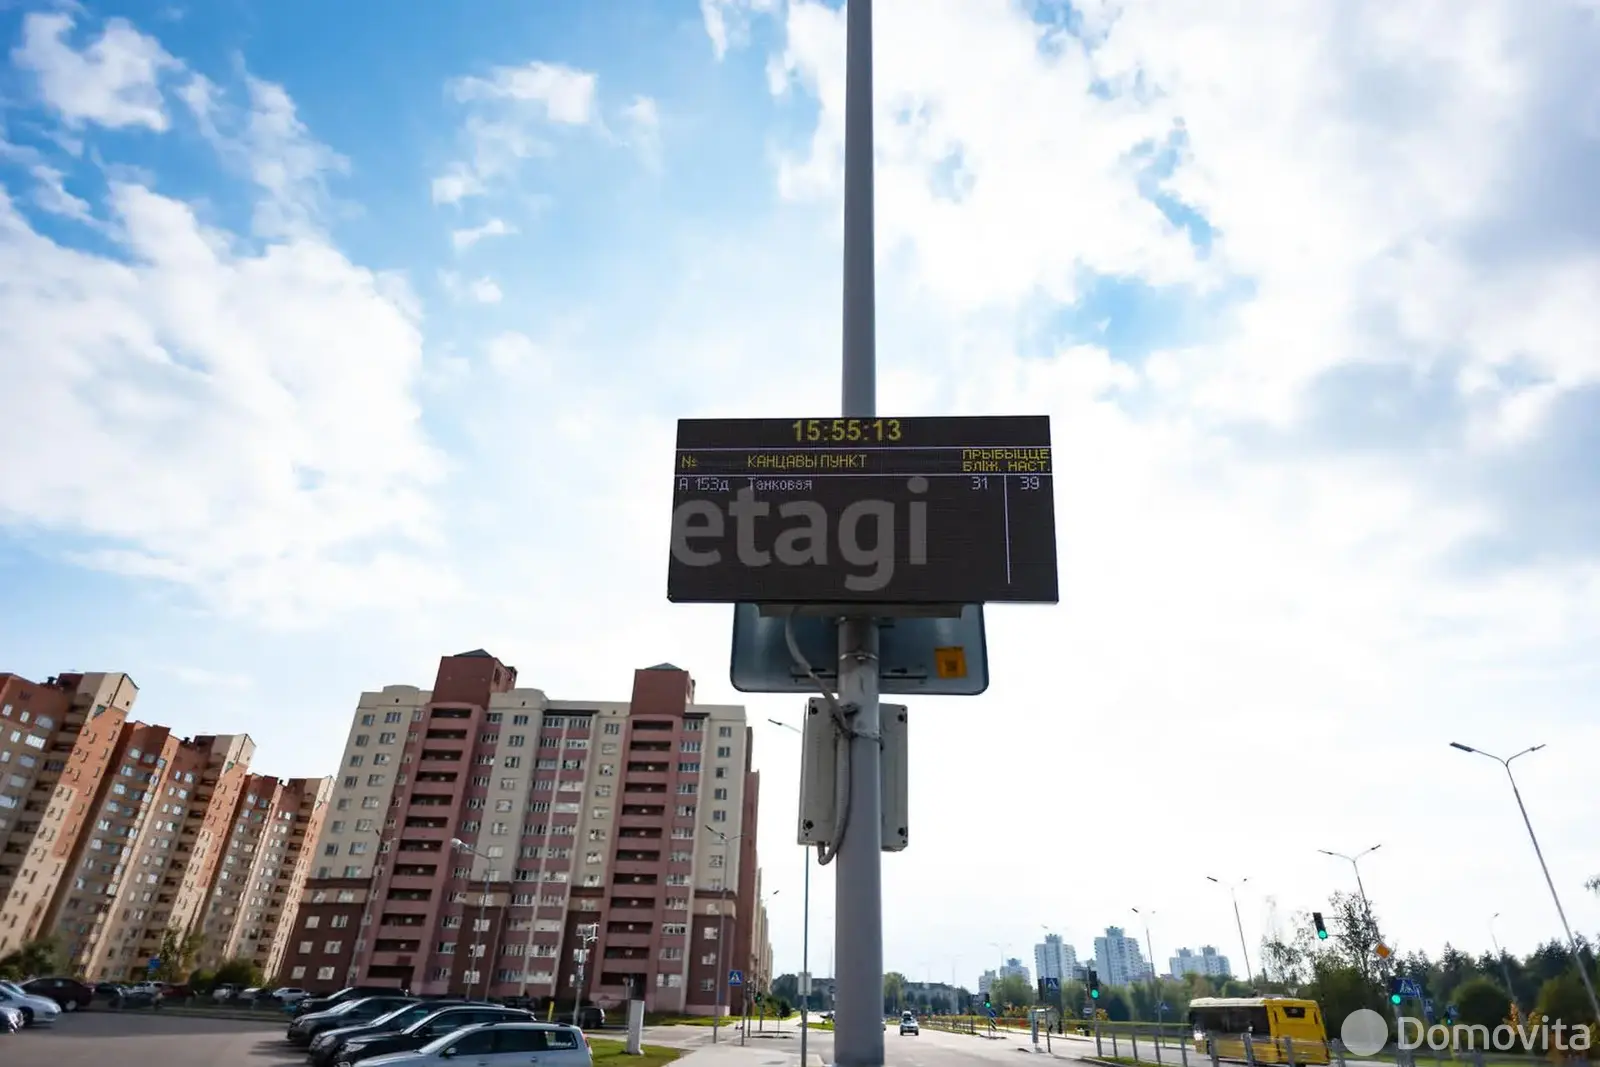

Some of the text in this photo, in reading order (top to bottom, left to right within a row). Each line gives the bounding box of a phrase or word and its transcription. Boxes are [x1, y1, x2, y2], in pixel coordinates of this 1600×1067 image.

[792, 419, 901, 442] 15:55:13
[747, 453, 867, 469] КАНЦАВЫ ПУНКТ
[962, 449, 1049, 461] ПРЫБЫЦЦЕ
[694, 478, 730, 492] 153д
[747, 478, 813, 492] Танковая
[971, 476, 988, 490] 31
[1020, 476, 1040, 490] 39
